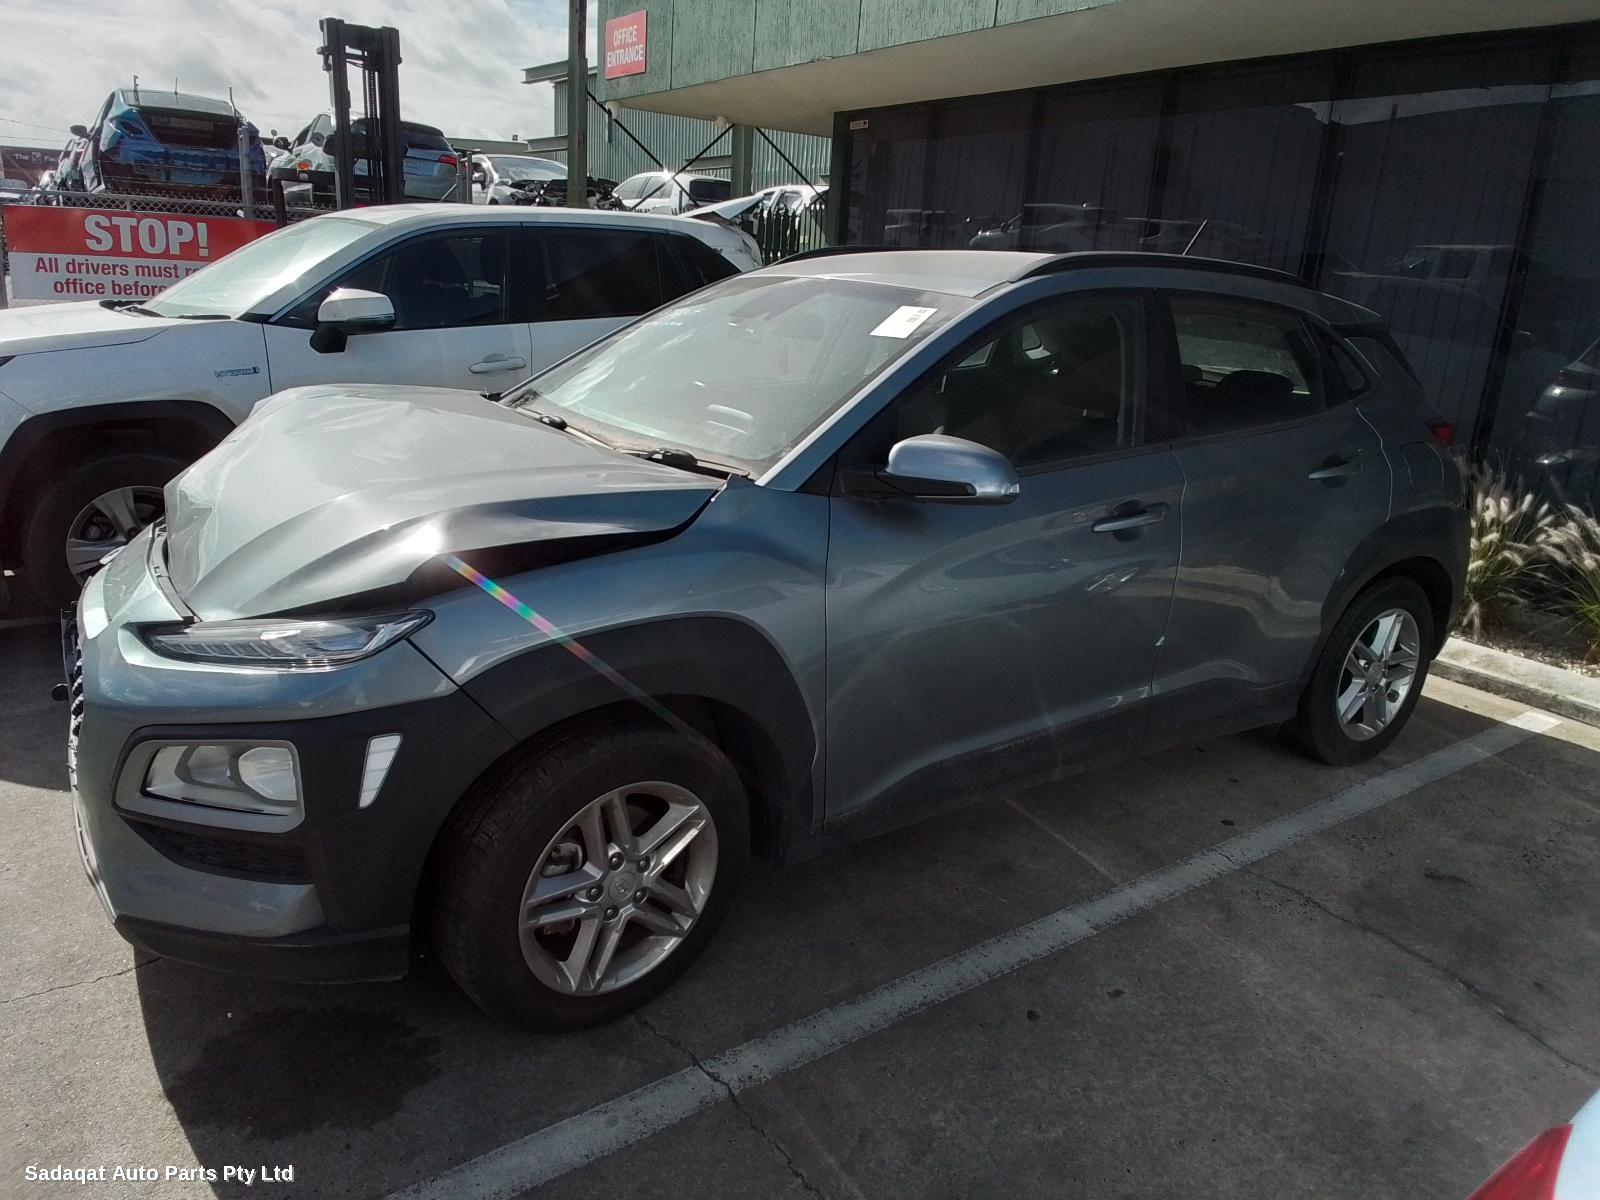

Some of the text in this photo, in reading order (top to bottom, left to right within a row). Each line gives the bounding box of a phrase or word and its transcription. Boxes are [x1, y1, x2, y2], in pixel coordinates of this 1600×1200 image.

[613, 24, 638, 47] OFFICE
[607, 43, 644, 68] ENTRANCE
[84, 214, 209, 257] STOP!
[35, 257, 59, 273] All
[65, 259, 129, 276] drivers
[135, 263, 180, 279] must
[53, 278, 106, 295] office
